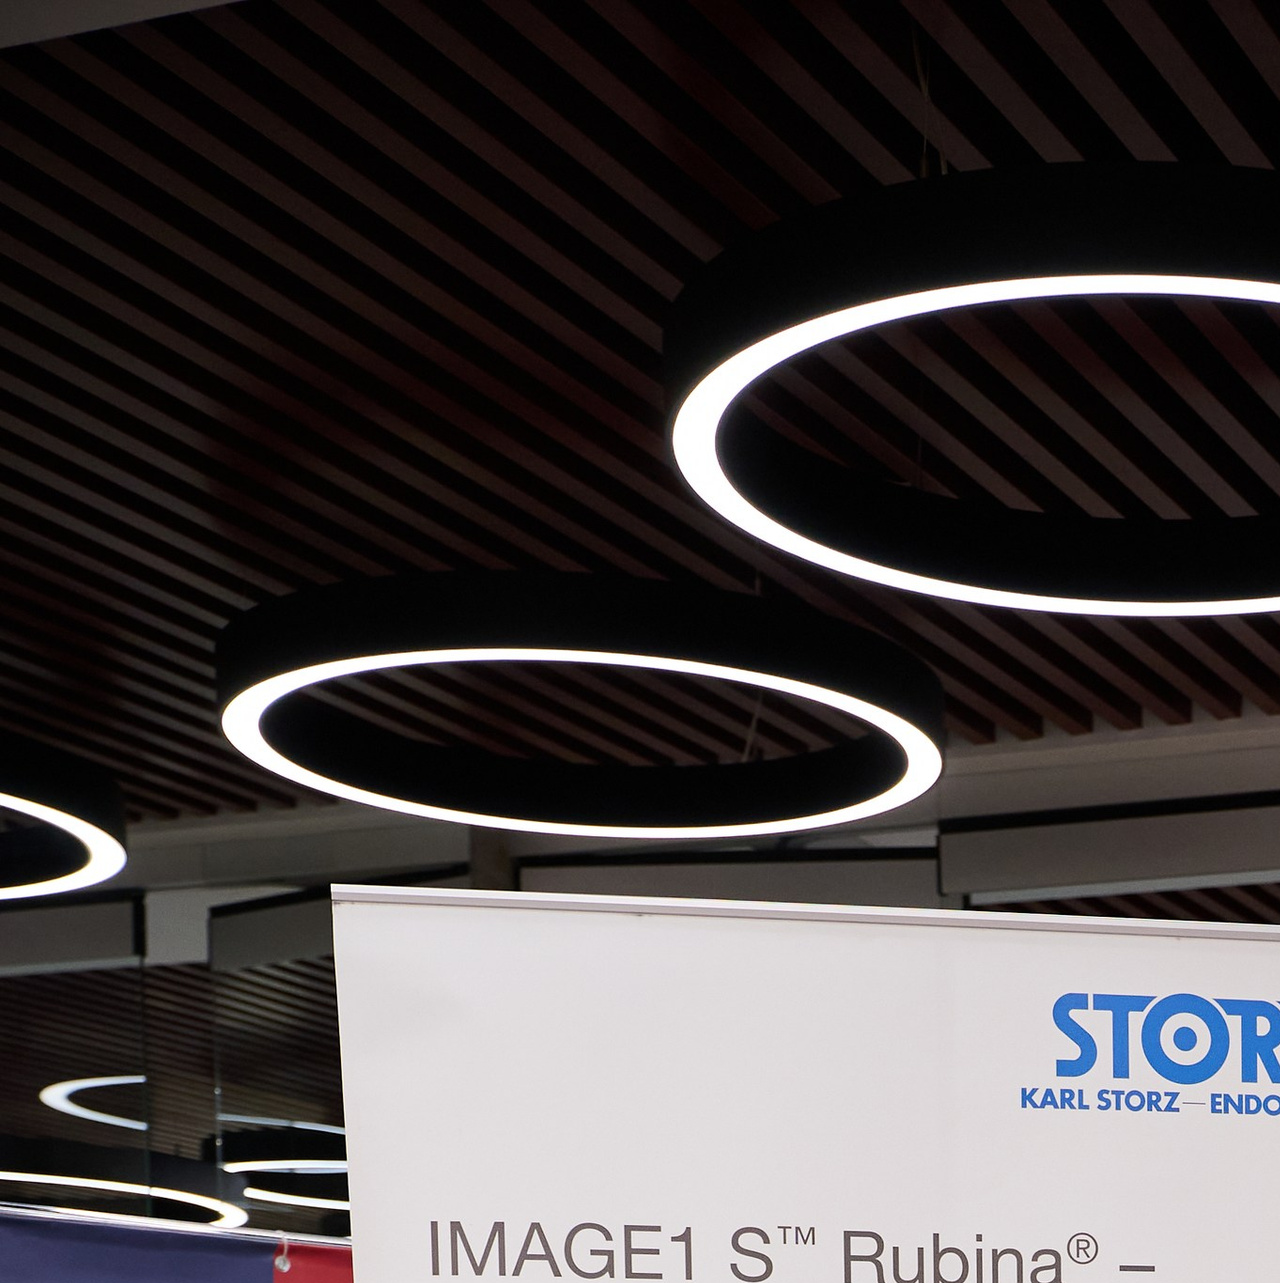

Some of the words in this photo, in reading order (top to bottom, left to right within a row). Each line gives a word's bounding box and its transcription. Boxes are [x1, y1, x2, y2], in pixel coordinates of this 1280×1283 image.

[1020, 1087, 1090, 1110] KARL
[1096, 1089, 1181, 1113] STORZ
[429, 1220, 693, 1281] IMAGE1
